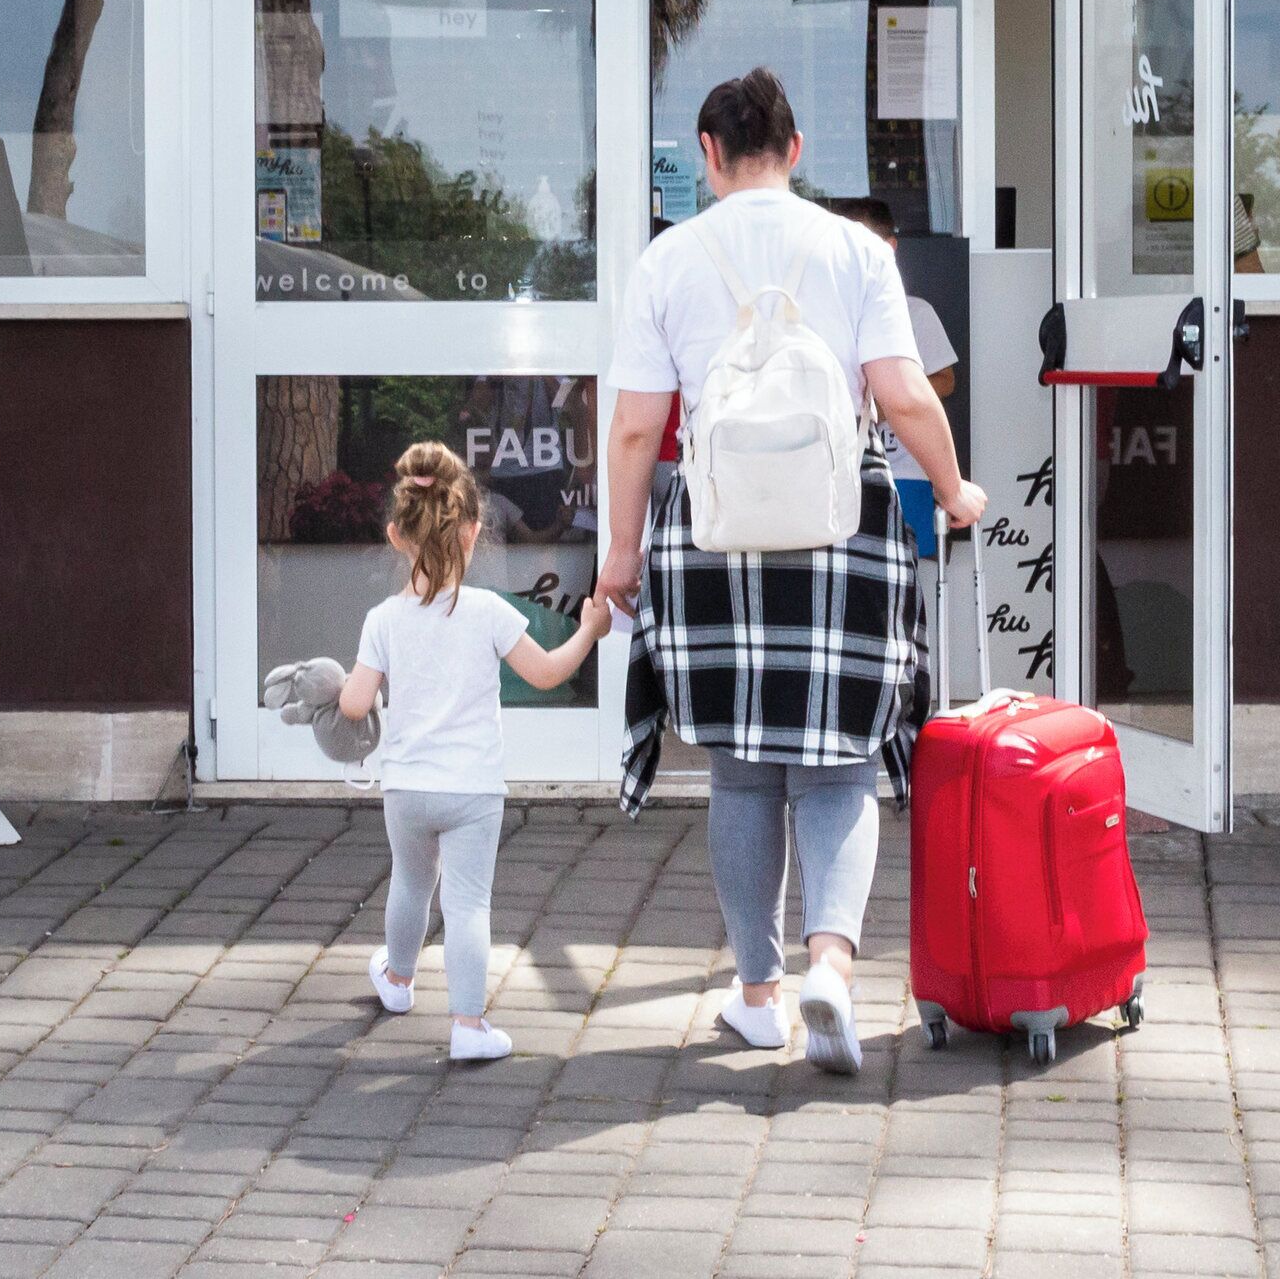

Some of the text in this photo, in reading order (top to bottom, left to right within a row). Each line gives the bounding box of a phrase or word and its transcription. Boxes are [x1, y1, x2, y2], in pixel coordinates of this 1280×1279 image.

[255, 268, 488, 293] welcome to
[466, 427, 595, 468] FABU
[982, 517, 1030, 547] hu
[986, 603, 1031, 633] hu
